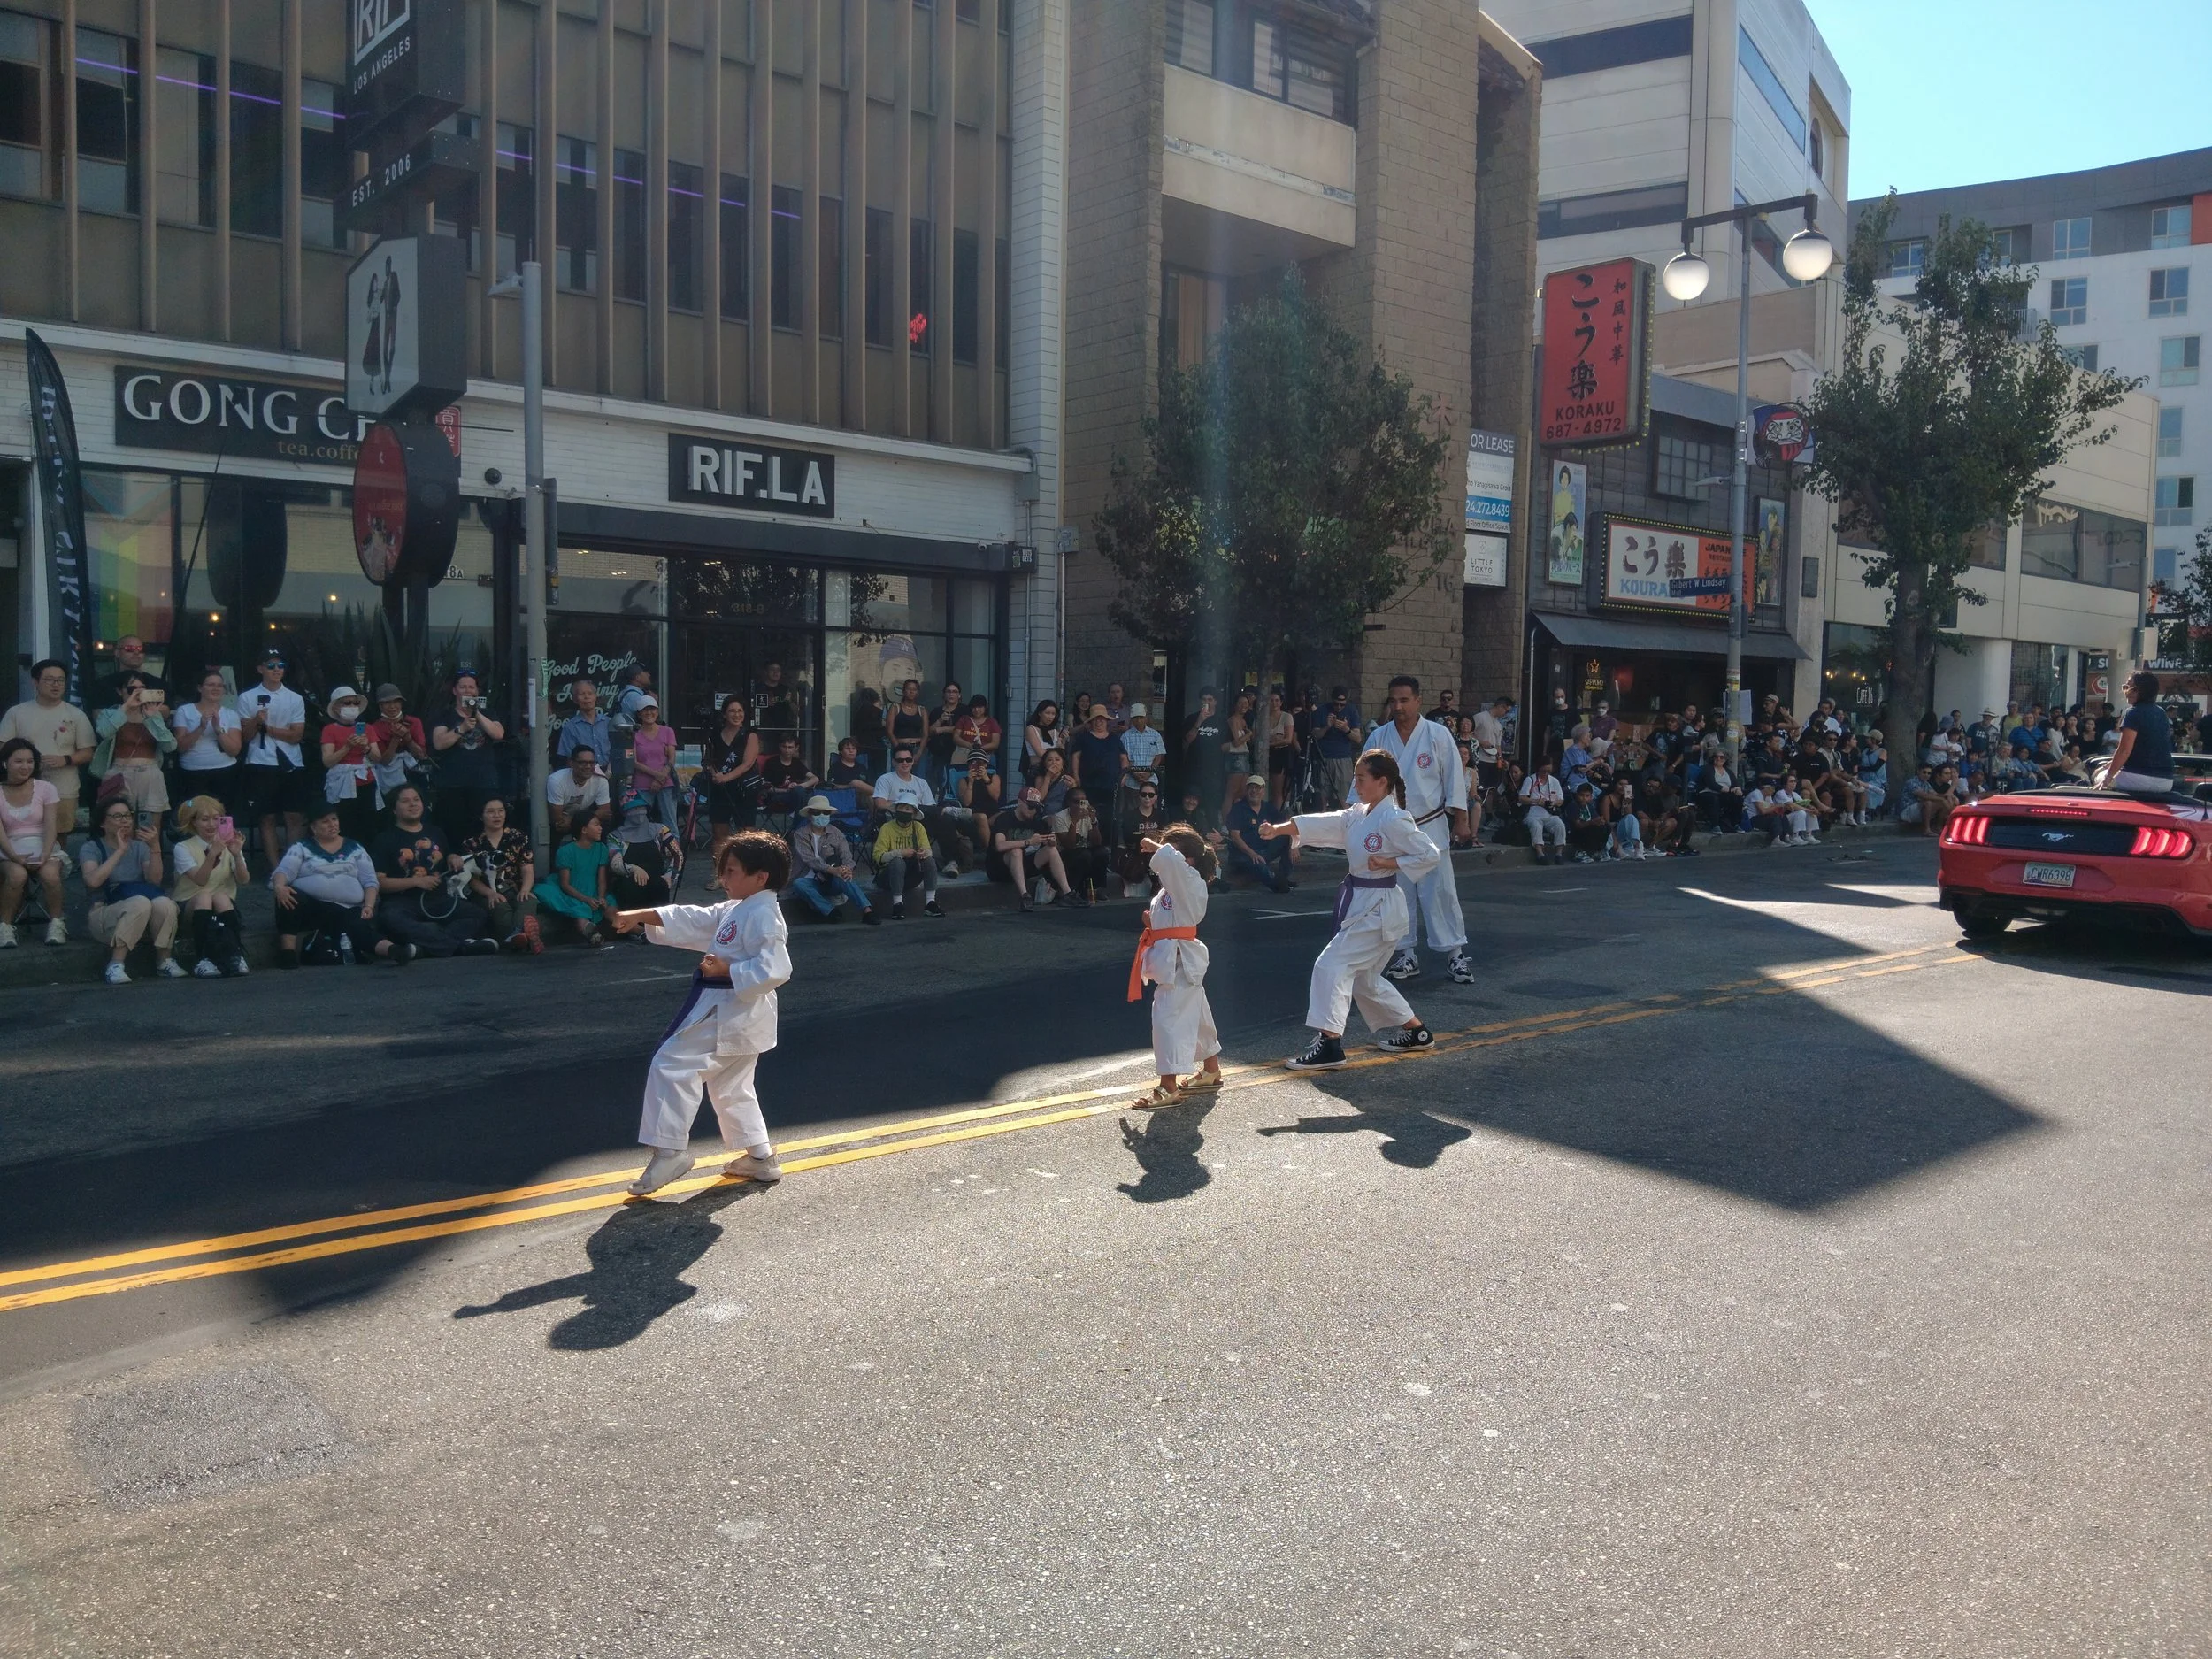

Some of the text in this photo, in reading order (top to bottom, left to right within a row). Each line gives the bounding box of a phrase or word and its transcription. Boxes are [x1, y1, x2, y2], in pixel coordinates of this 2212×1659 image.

[354, 36, 411, 95] LOS ANGELES
[352, 153, 411, 207] EST. 2006
[1567, 273, 1600, 402] こう楽
[1609, 278, 1626, 365] 和風中華
[124, 374, 298, 434] GONG
[1555, 401, 1615, 421] KORAKU
[1470, 433, 1515, 454] OR LEASE
[688, 445, 826, 505] RIF.LA
[1465, 500, 1510, 518] 24.272.8439
[1471, 557, 1493, 566] LITTLE
[1622, 535, 1686, 578] こう楽
[1620, 578, 1671, 598] KOURA
[1671, 580, 1692, 589] Gilbert
[1701, 578, 1727, 588] Lindsay
